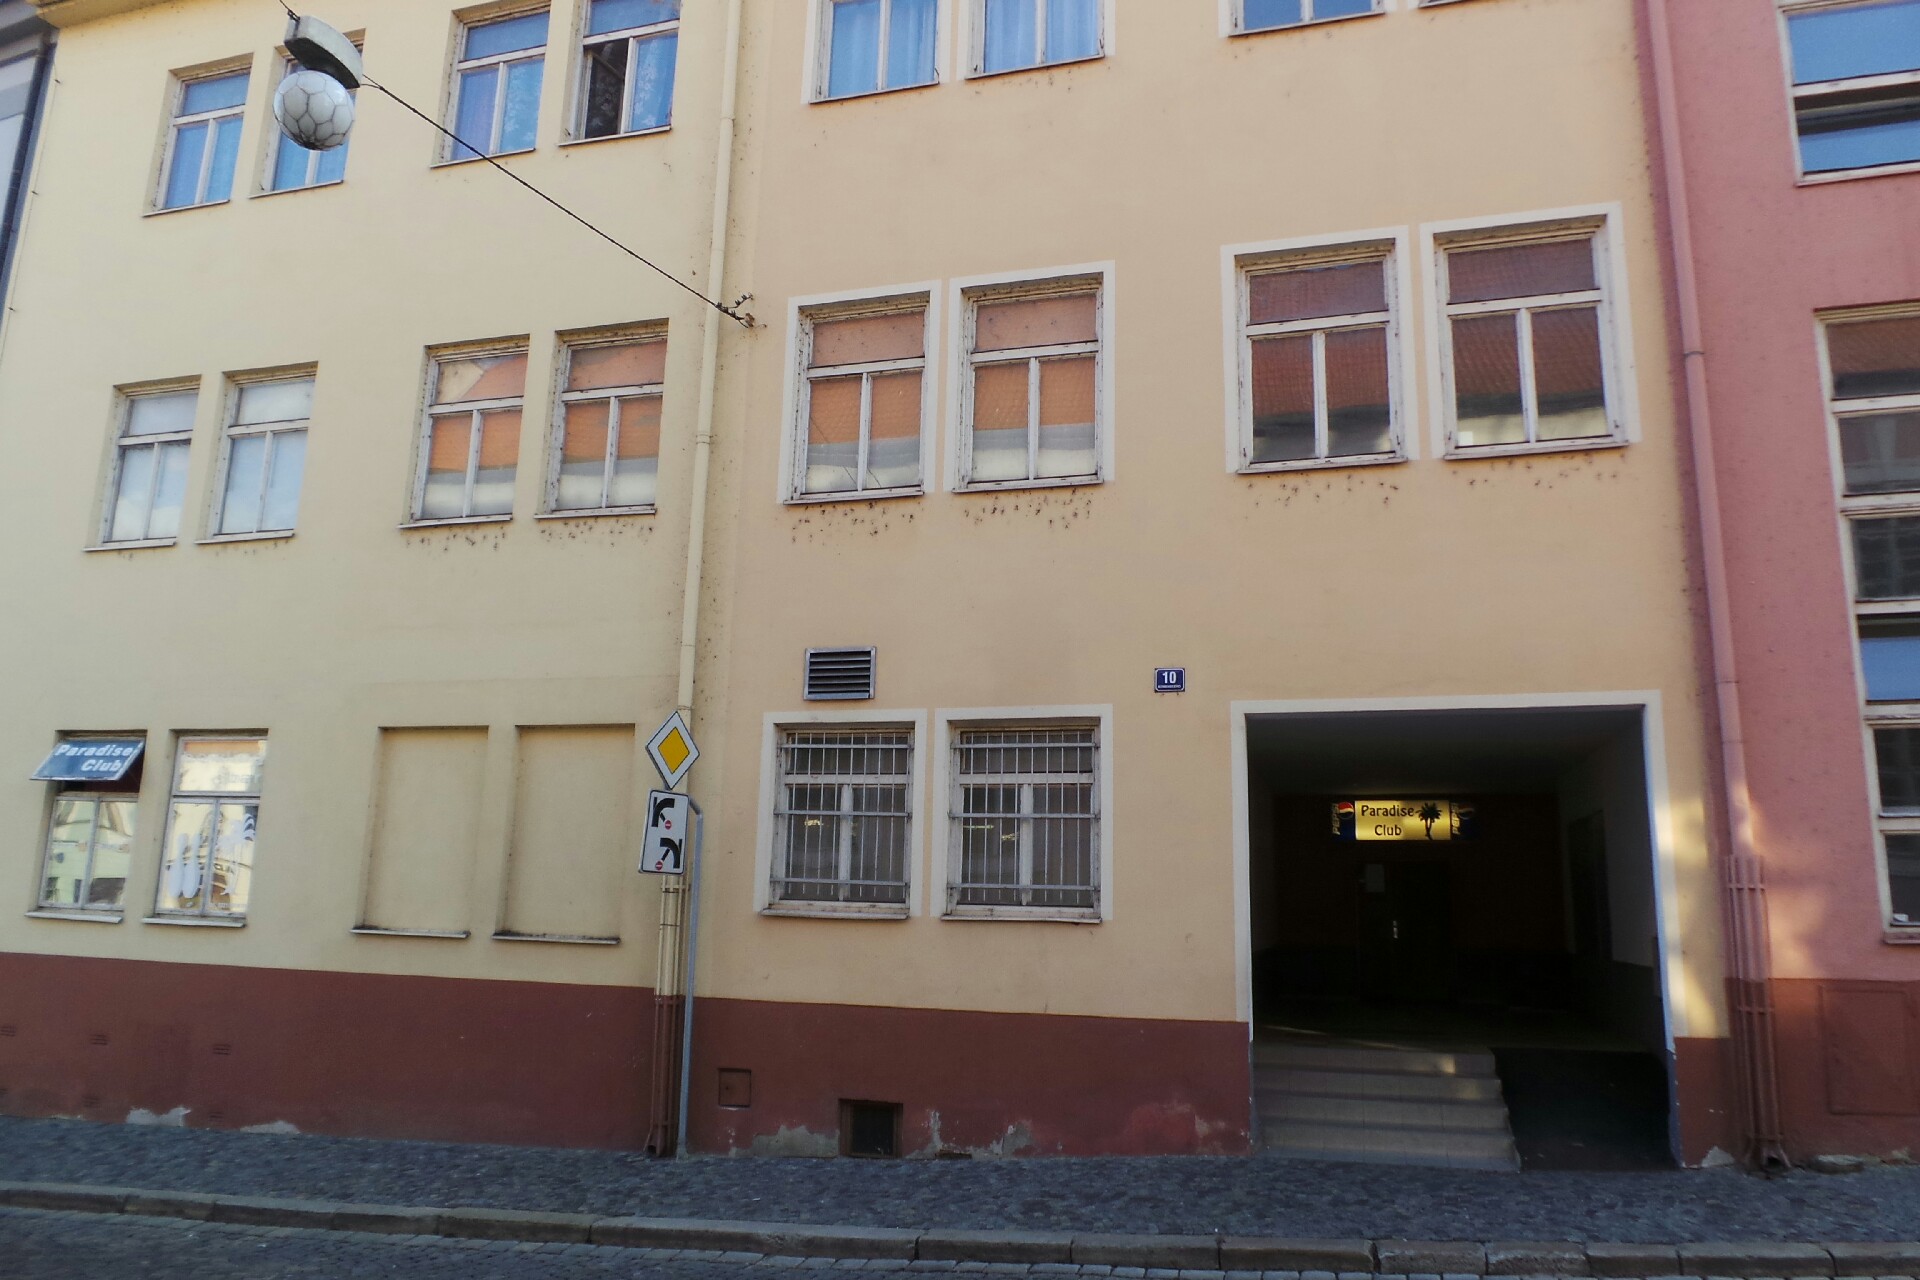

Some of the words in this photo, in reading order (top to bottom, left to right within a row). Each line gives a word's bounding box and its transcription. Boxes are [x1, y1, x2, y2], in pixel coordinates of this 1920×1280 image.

[1162, 671, 1177, 684] 10
[54, 744, 135, 756] Paradise
[80, 760, 122, 772] Club
[1361, 805, 1415, 817] Paradise
[1374, 824, 1402, 836] Club
